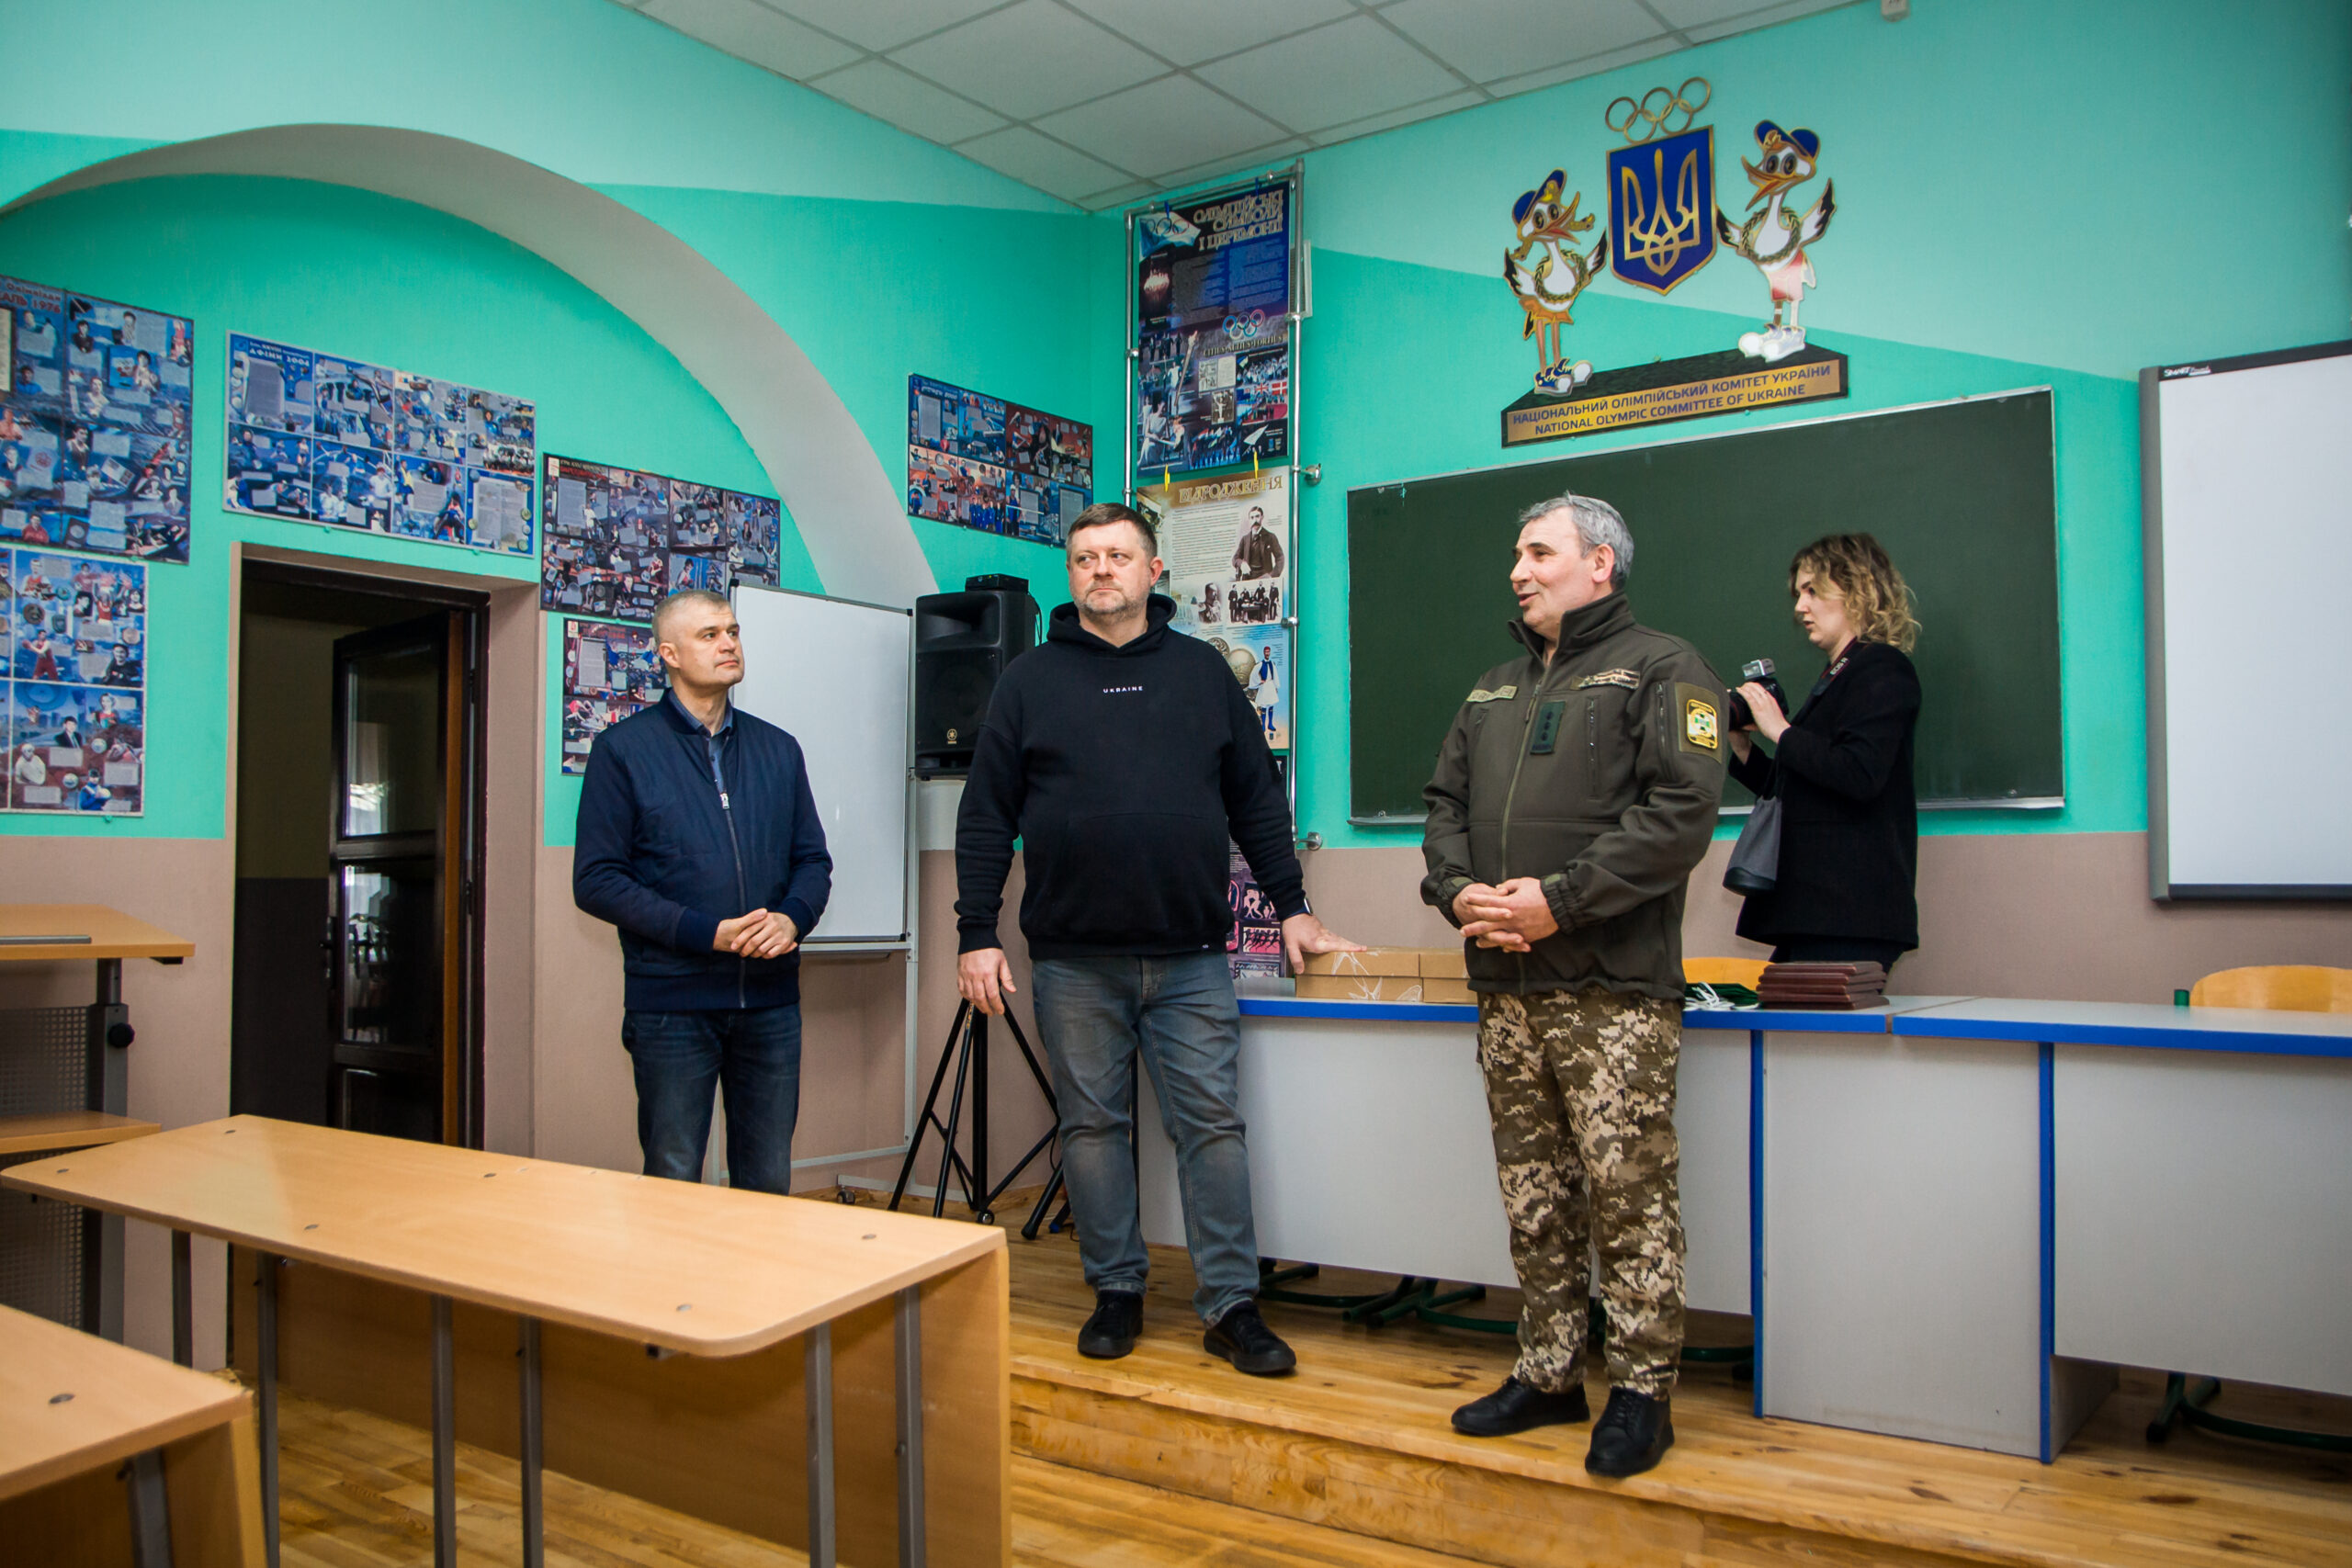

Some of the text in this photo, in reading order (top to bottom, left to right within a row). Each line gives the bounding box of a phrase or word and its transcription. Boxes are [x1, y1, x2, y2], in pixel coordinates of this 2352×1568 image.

[1513, 365, 1830, 424] НАЦІОНАЛЬНИЙ ОЛІМПІЙСЬКИЙ КОМІТЕТ УКРАЇНИ
[1535, 384, 1806, 434] NATIONAL OLYMPIC COMMITTEE OF UKRAINE
[1179, 475, 1283, 504] ВІДРОДЖЕННЯ
[1102, 685, 1144, 694] UKRAINE
